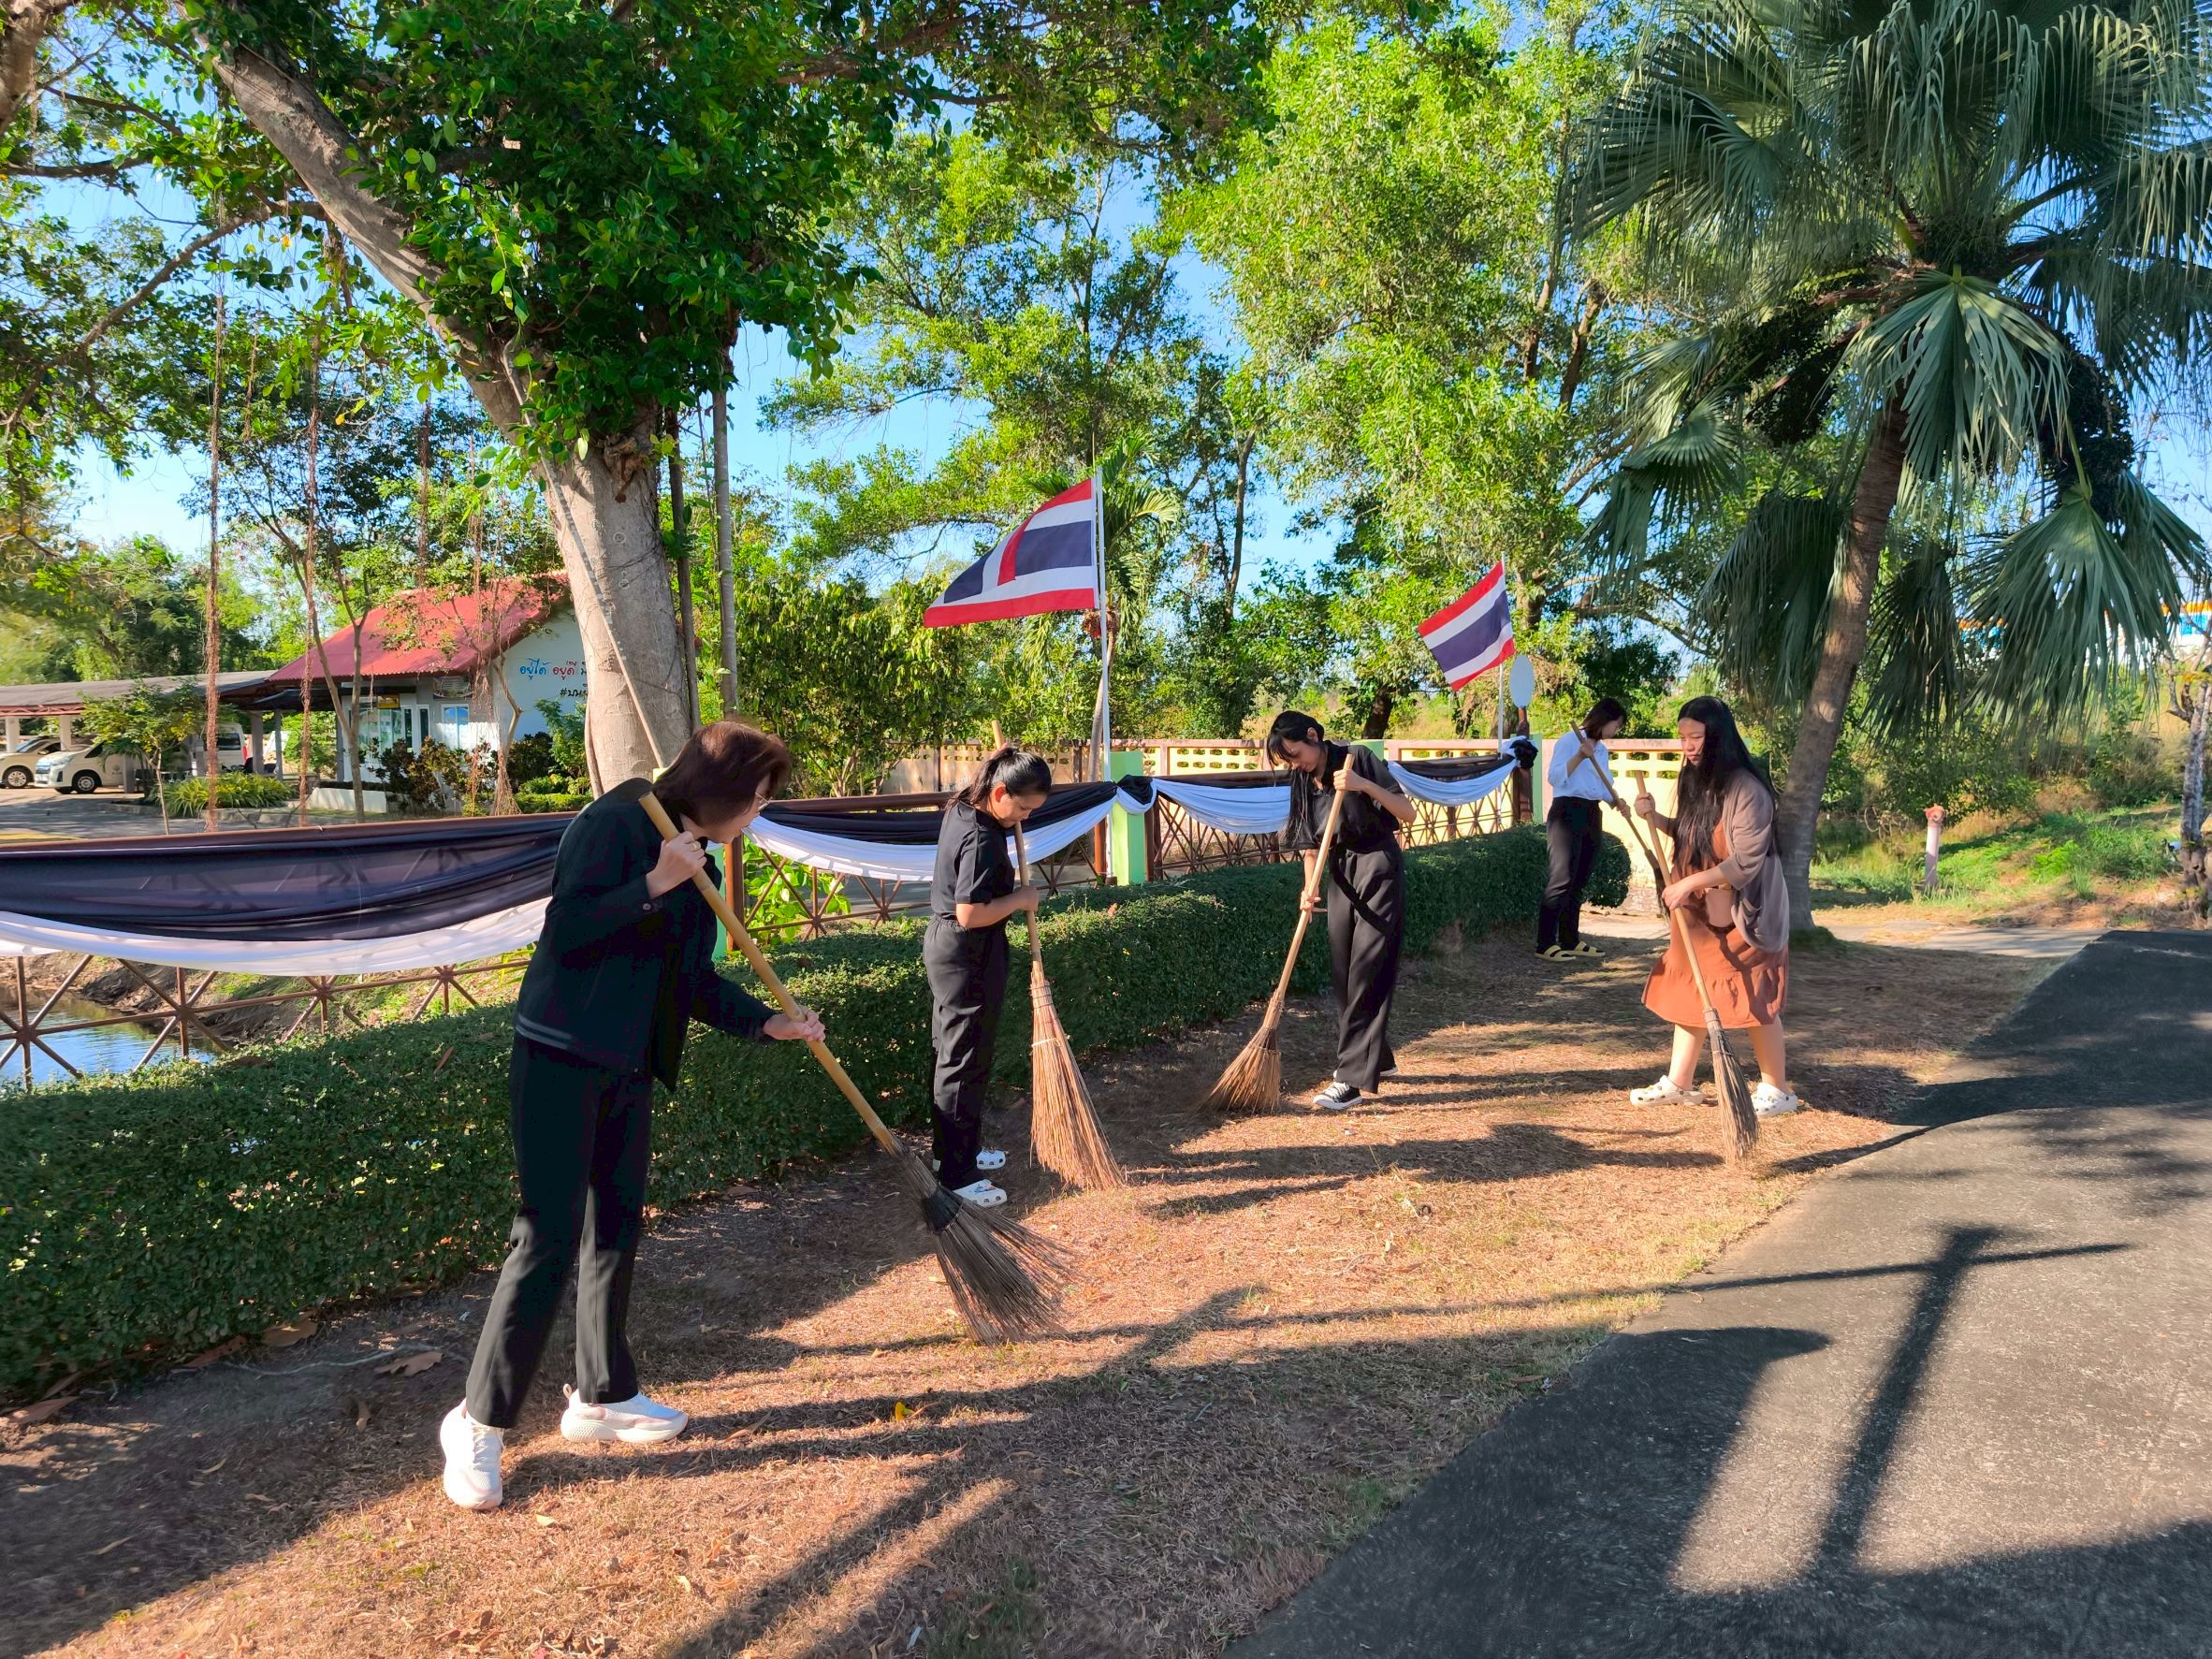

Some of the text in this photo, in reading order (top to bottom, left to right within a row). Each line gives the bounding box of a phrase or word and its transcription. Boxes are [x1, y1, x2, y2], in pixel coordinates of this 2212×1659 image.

[519, 658, 551, 680] อยู่ได้
[552, 661, 577, 681] อยู่ดี
